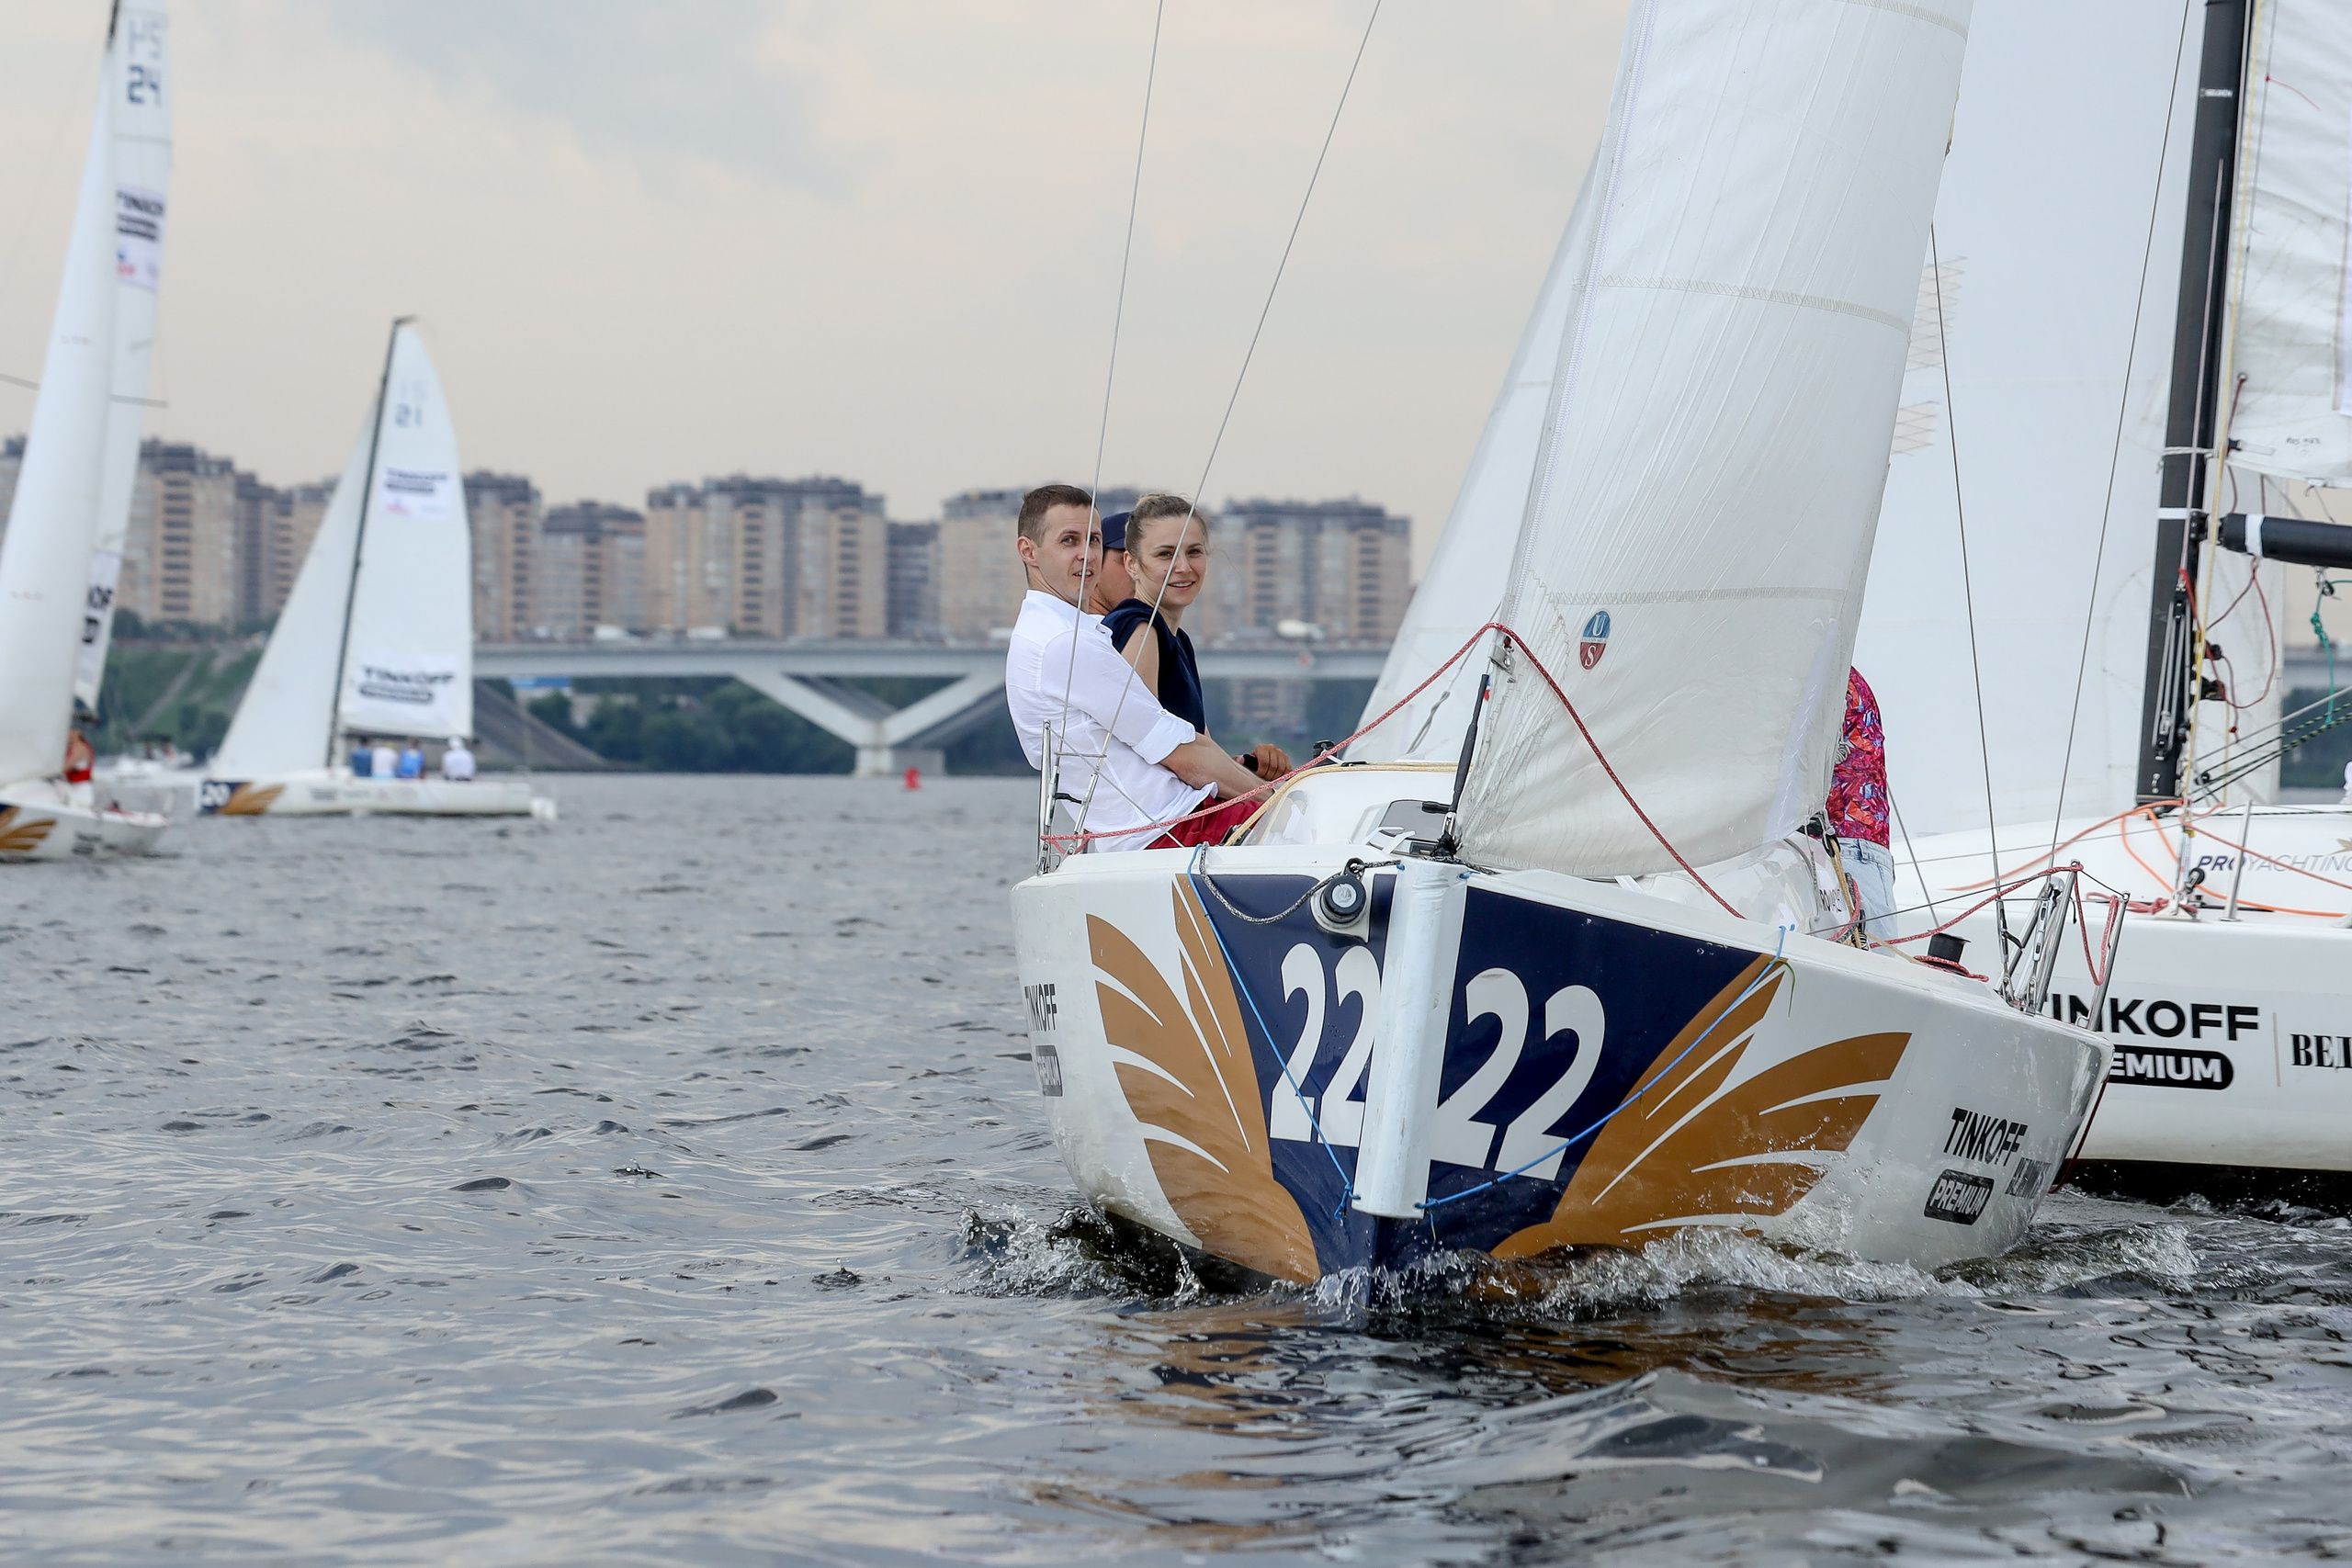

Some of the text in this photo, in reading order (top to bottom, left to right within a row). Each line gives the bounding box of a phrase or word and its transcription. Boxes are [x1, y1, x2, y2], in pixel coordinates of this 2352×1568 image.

[2043, 992, 2259, 1042] INKOFF
[1270, 942, 1382, 1148] 22
[2109, 1052, 2222, 1083] EMIUM
[1430, 967, 1606, 1181] 22
[1943, 1107, 2029, 1167] TINKOFF
[1929, 1178, 1990, 1217] PREMIUM
